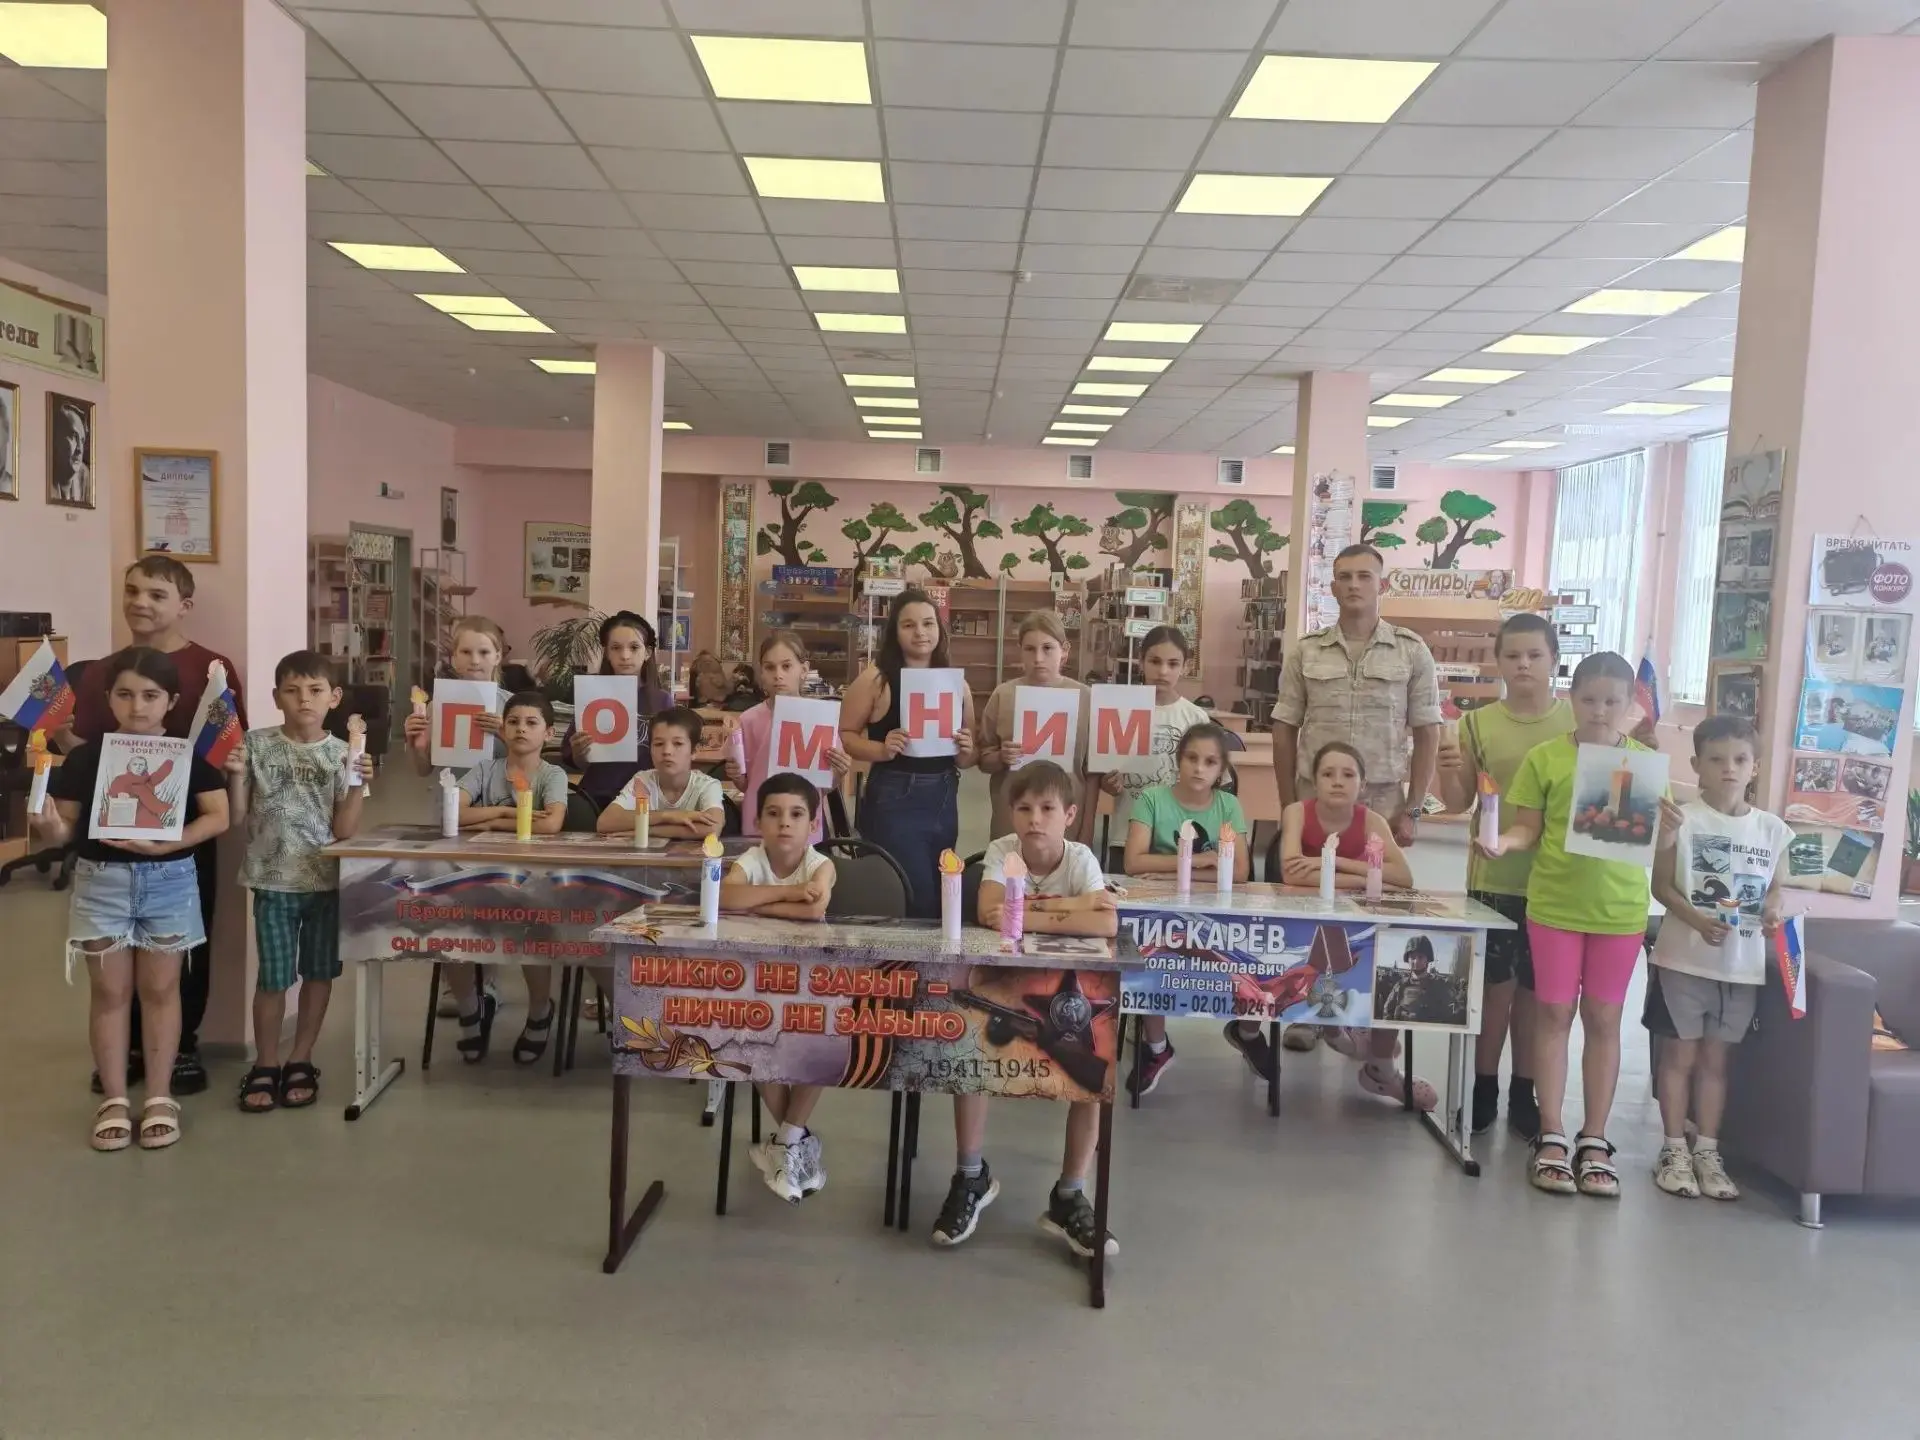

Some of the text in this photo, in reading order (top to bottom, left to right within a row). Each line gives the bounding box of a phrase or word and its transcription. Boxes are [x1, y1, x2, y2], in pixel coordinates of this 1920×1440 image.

[1825, 538, 1865, 550] ВРЕМЯ
[1873, 574, 1908, 585] ФОТО
[1873, 584, 1905, 593] КОНКУРС
[441, 702, 485, 750] П
[581, 698, 629, 744] О
[908, 692, 953, 739] Н
[1021, 710, 1068, 756] И
[1097, 708, 1152, 756] М
[777, 720, 834, 771] М
[397, 899, 466, 923] Герой
[570, 908, 597, 924] не
[391, 936, 605, 959] он вечно в народе
[631, 953, 745, 991] НИКТО
[754, 960, 799, 994] НЕ
[808, 963, 919, 999] ЗАБЫТ
[1190, 956, 1285, 977] Николаевич
[1160, 973, 1241, 993] Лейтенант
[663, 995, 968, 1041] НИЧТО НЕ ЗАБЫТО
[1191, 994, 1265, 1017] 02.01.2024
[923, 1058, 1051, 1079] 1941-1945
